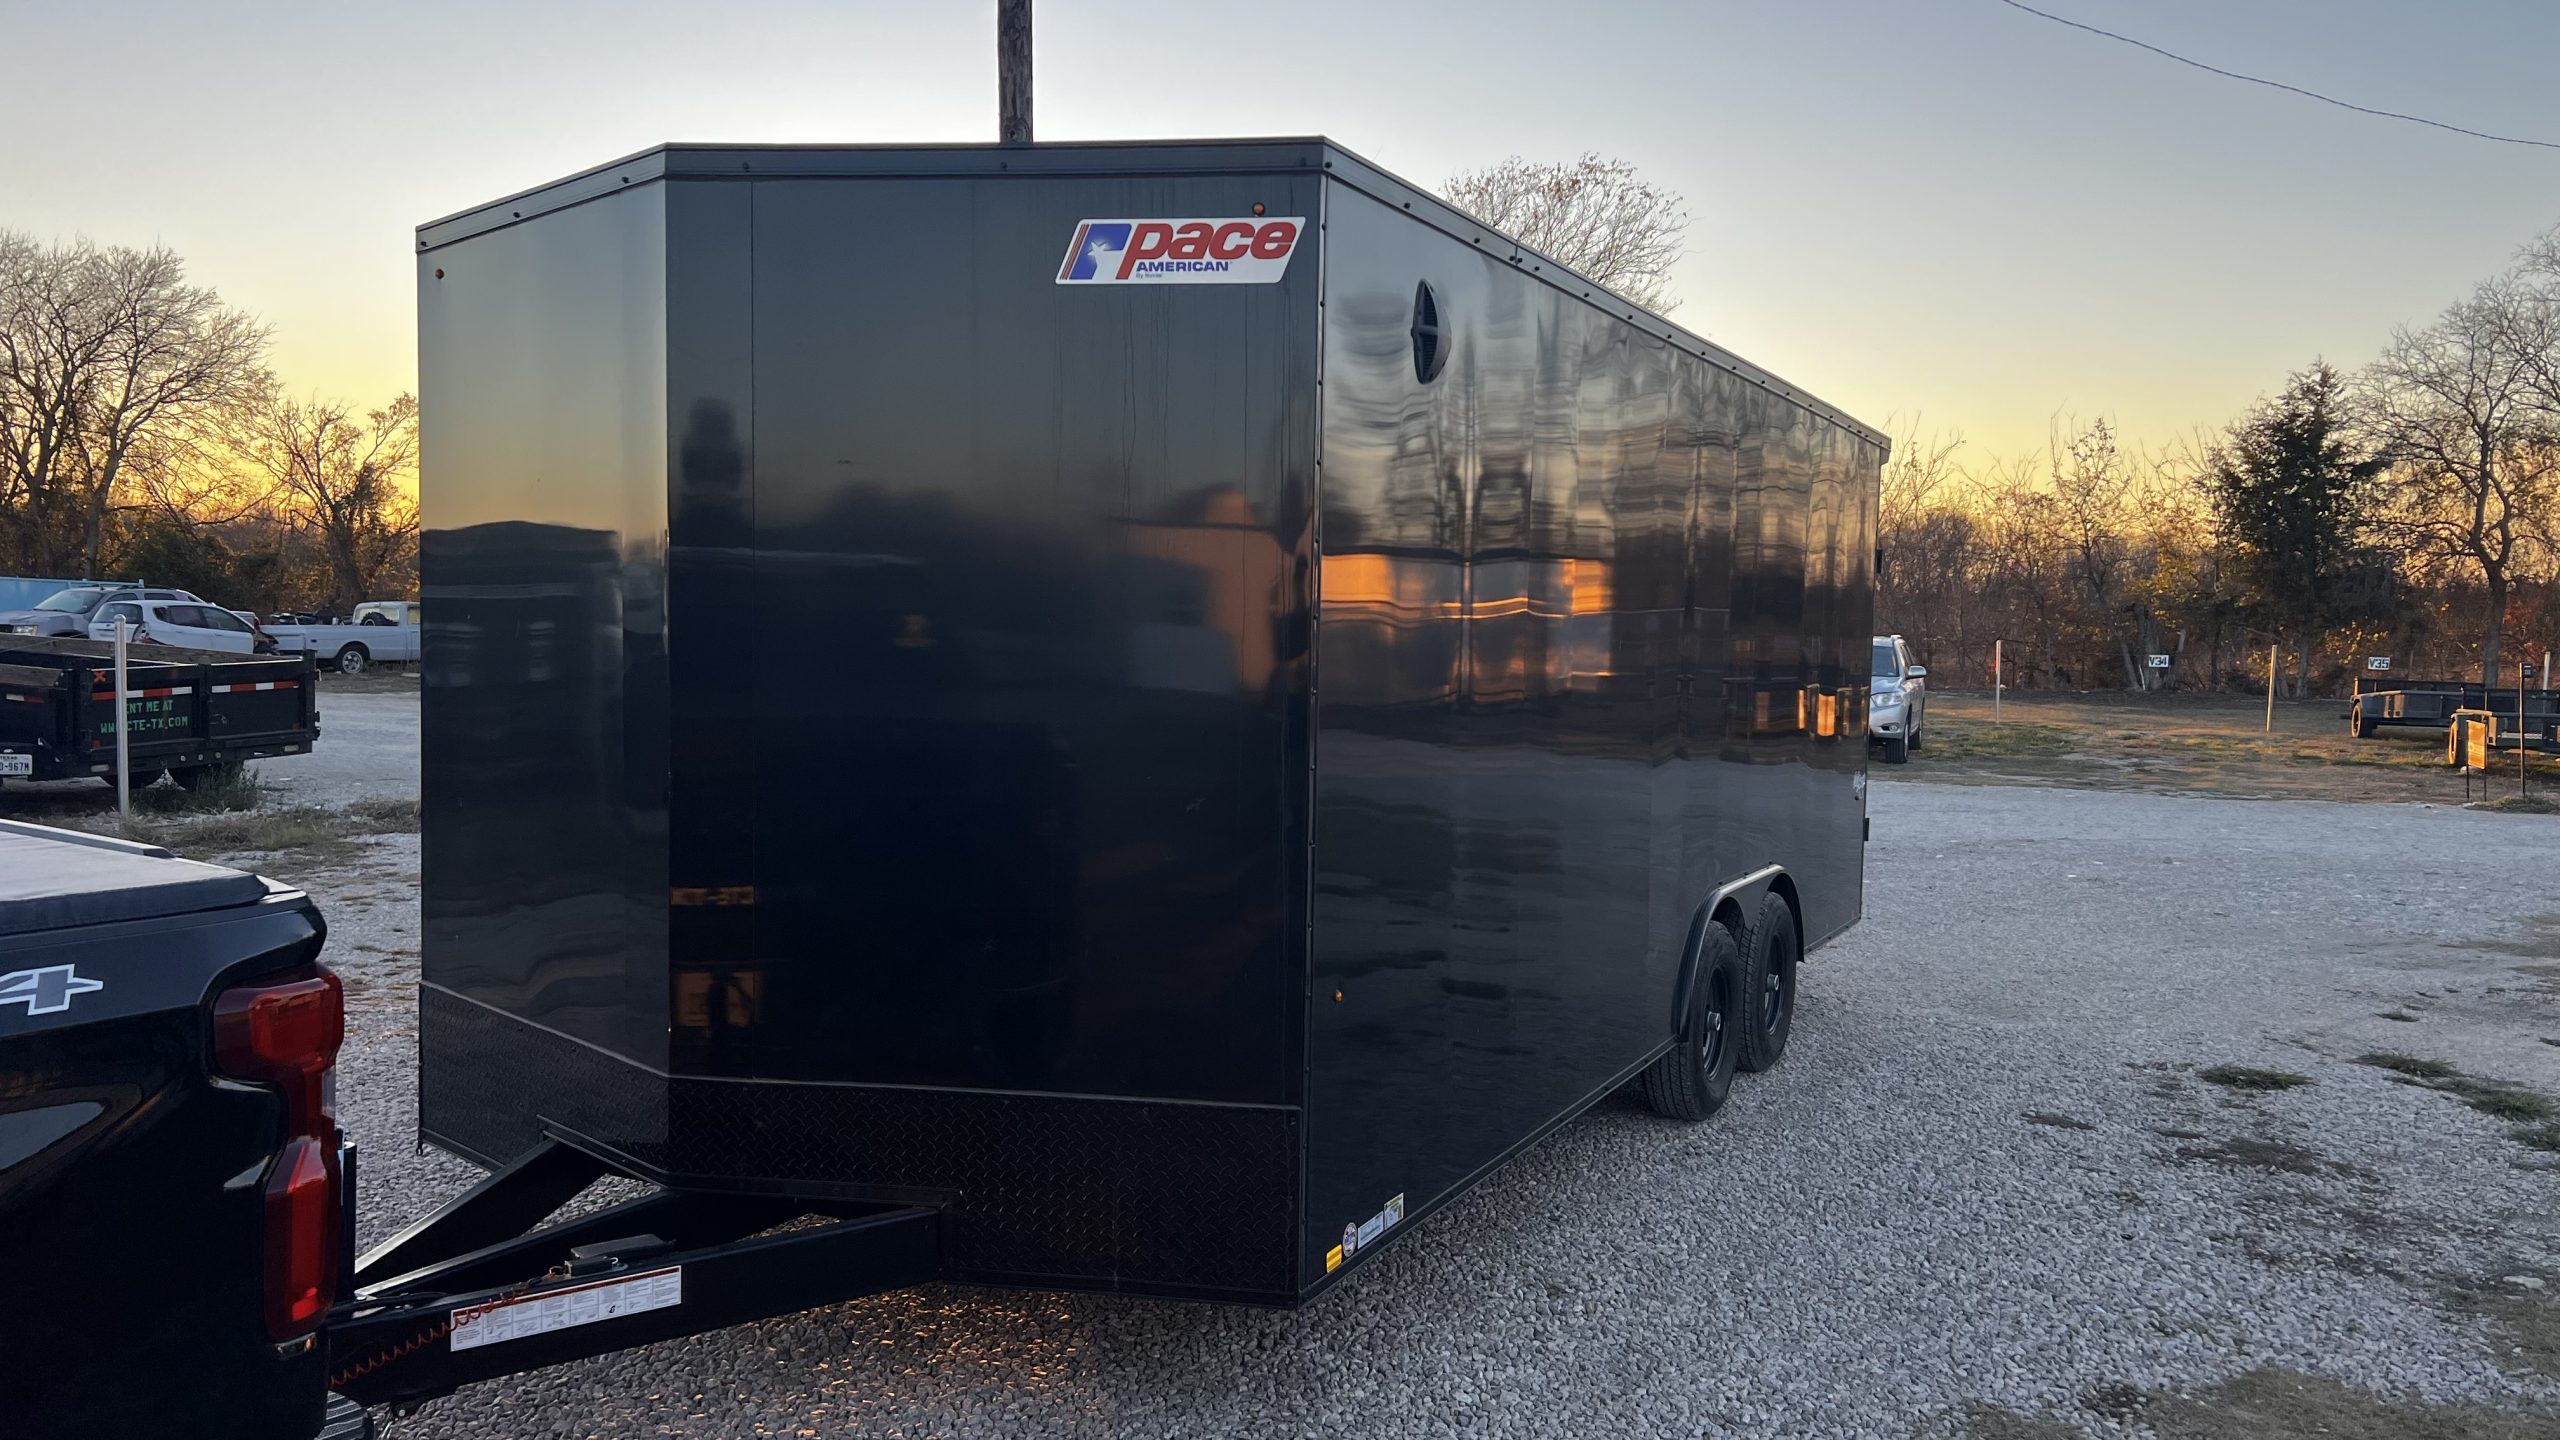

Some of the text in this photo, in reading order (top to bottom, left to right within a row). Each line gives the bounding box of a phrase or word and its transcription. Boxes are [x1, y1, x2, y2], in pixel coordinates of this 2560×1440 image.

[1115, 222, 1297, 280] pace
[1136, 261, 1229, 272] AMERICAN
[2149, 656, 2167, 666] V34
[2369, 658, 2389, 669] V35
[146, 701, 160, 712] ME
[162, 700, 173, 711] AT
